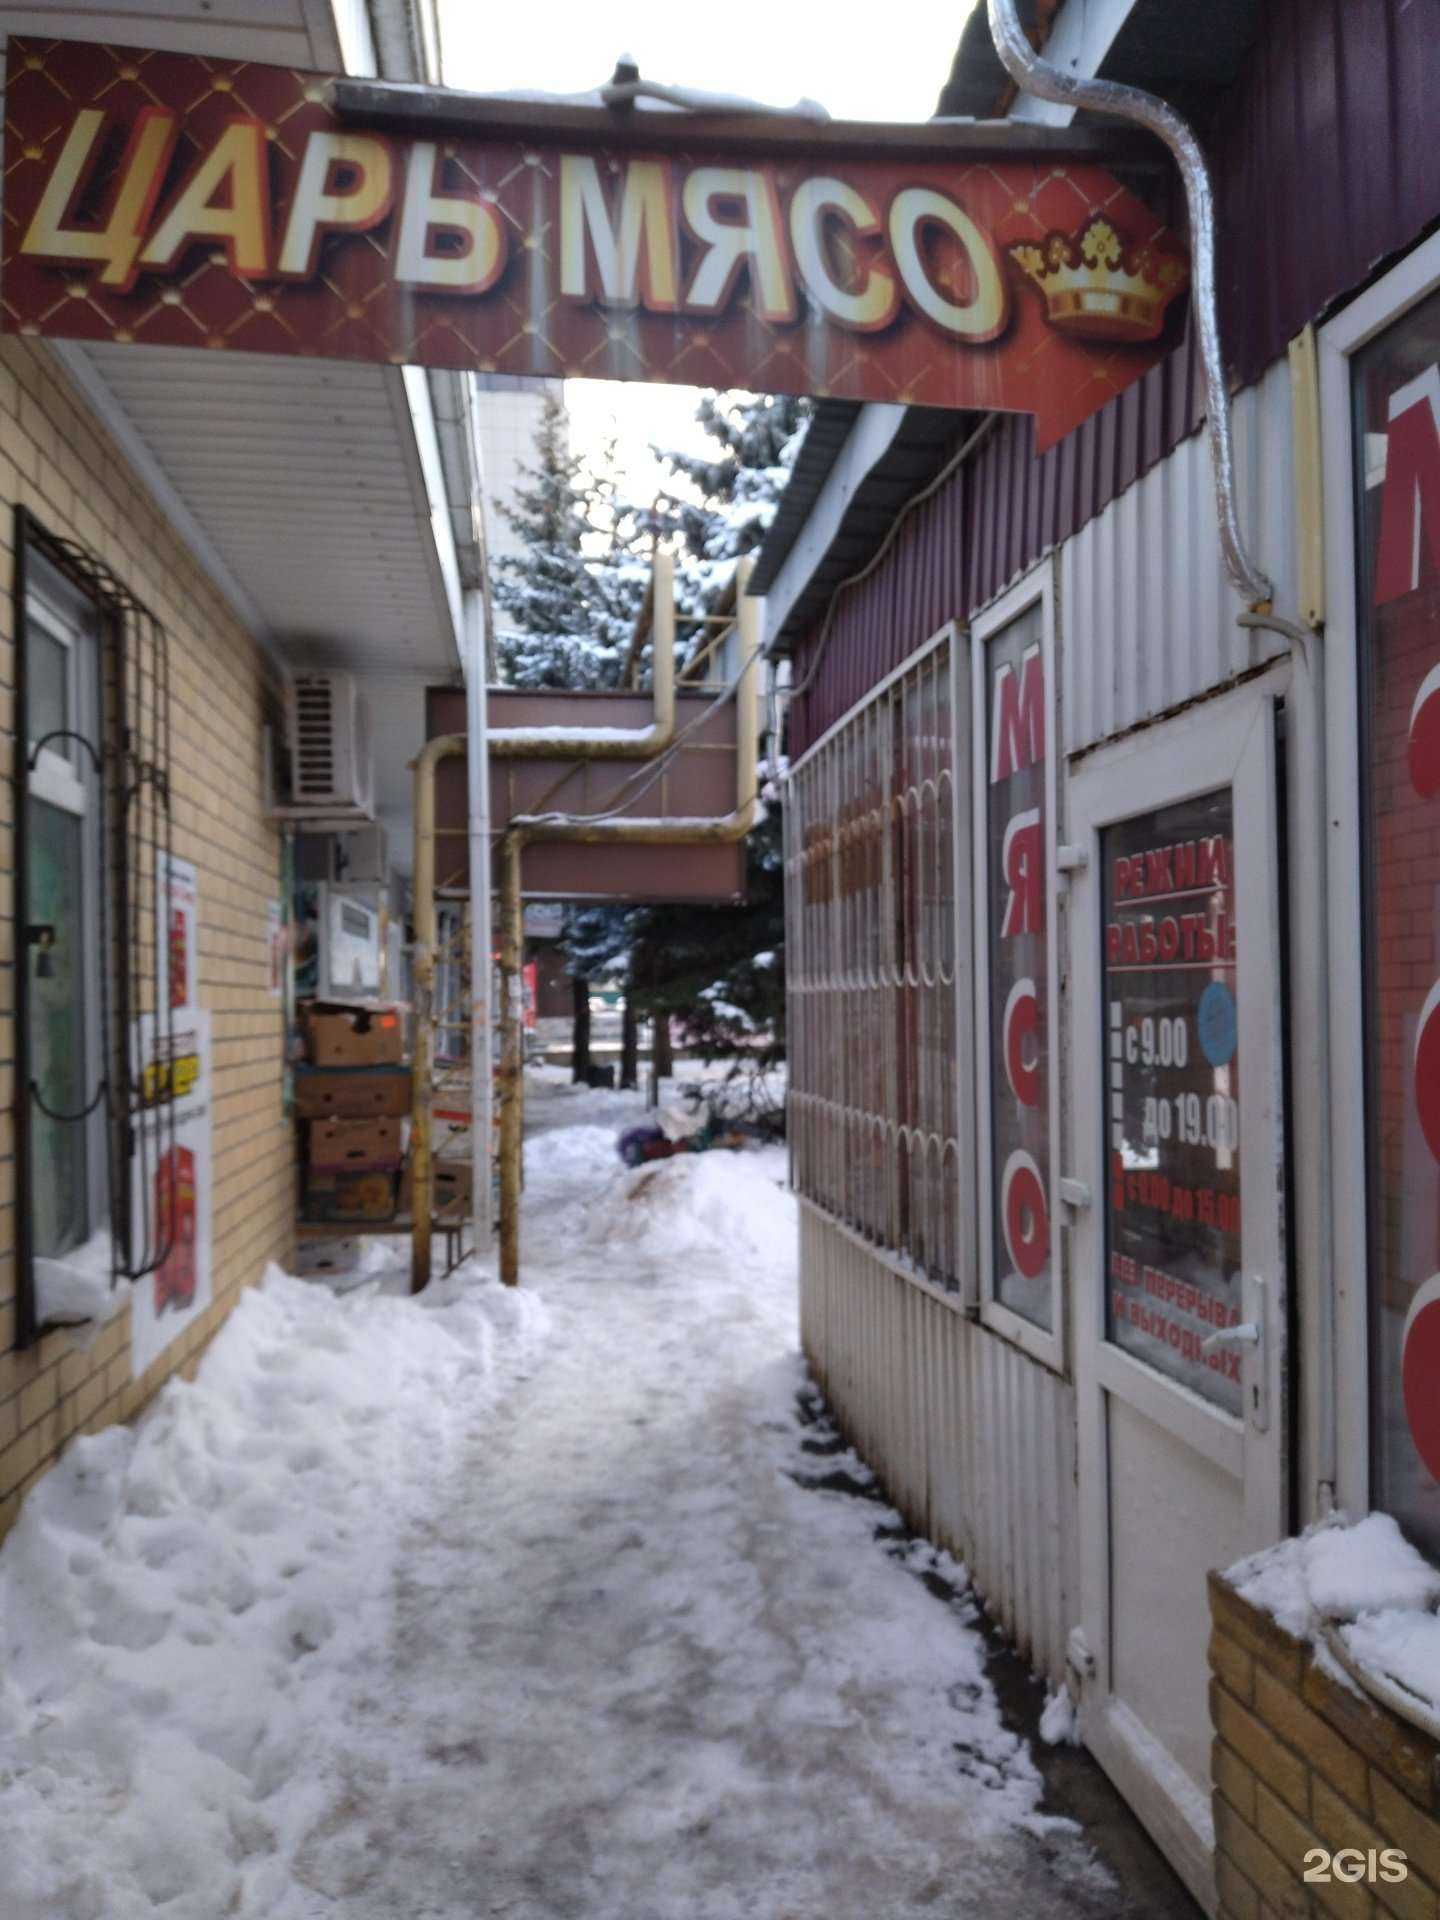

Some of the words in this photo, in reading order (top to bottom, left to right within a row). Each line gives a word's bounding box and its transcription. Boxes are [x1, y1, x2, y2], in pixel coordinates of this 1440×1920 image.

[20, 108, 502, 288] ЦАРЬ
[559, 154, 1002, 340] МЯСО
[1114, 834, 1228, 898] РЕЖИМ
[990, 643, 1049, 1281] МЯСО
[1142, 1017, 1188, 1068] 9.00
[1175, 1092, 1238, 1150] 19.00
